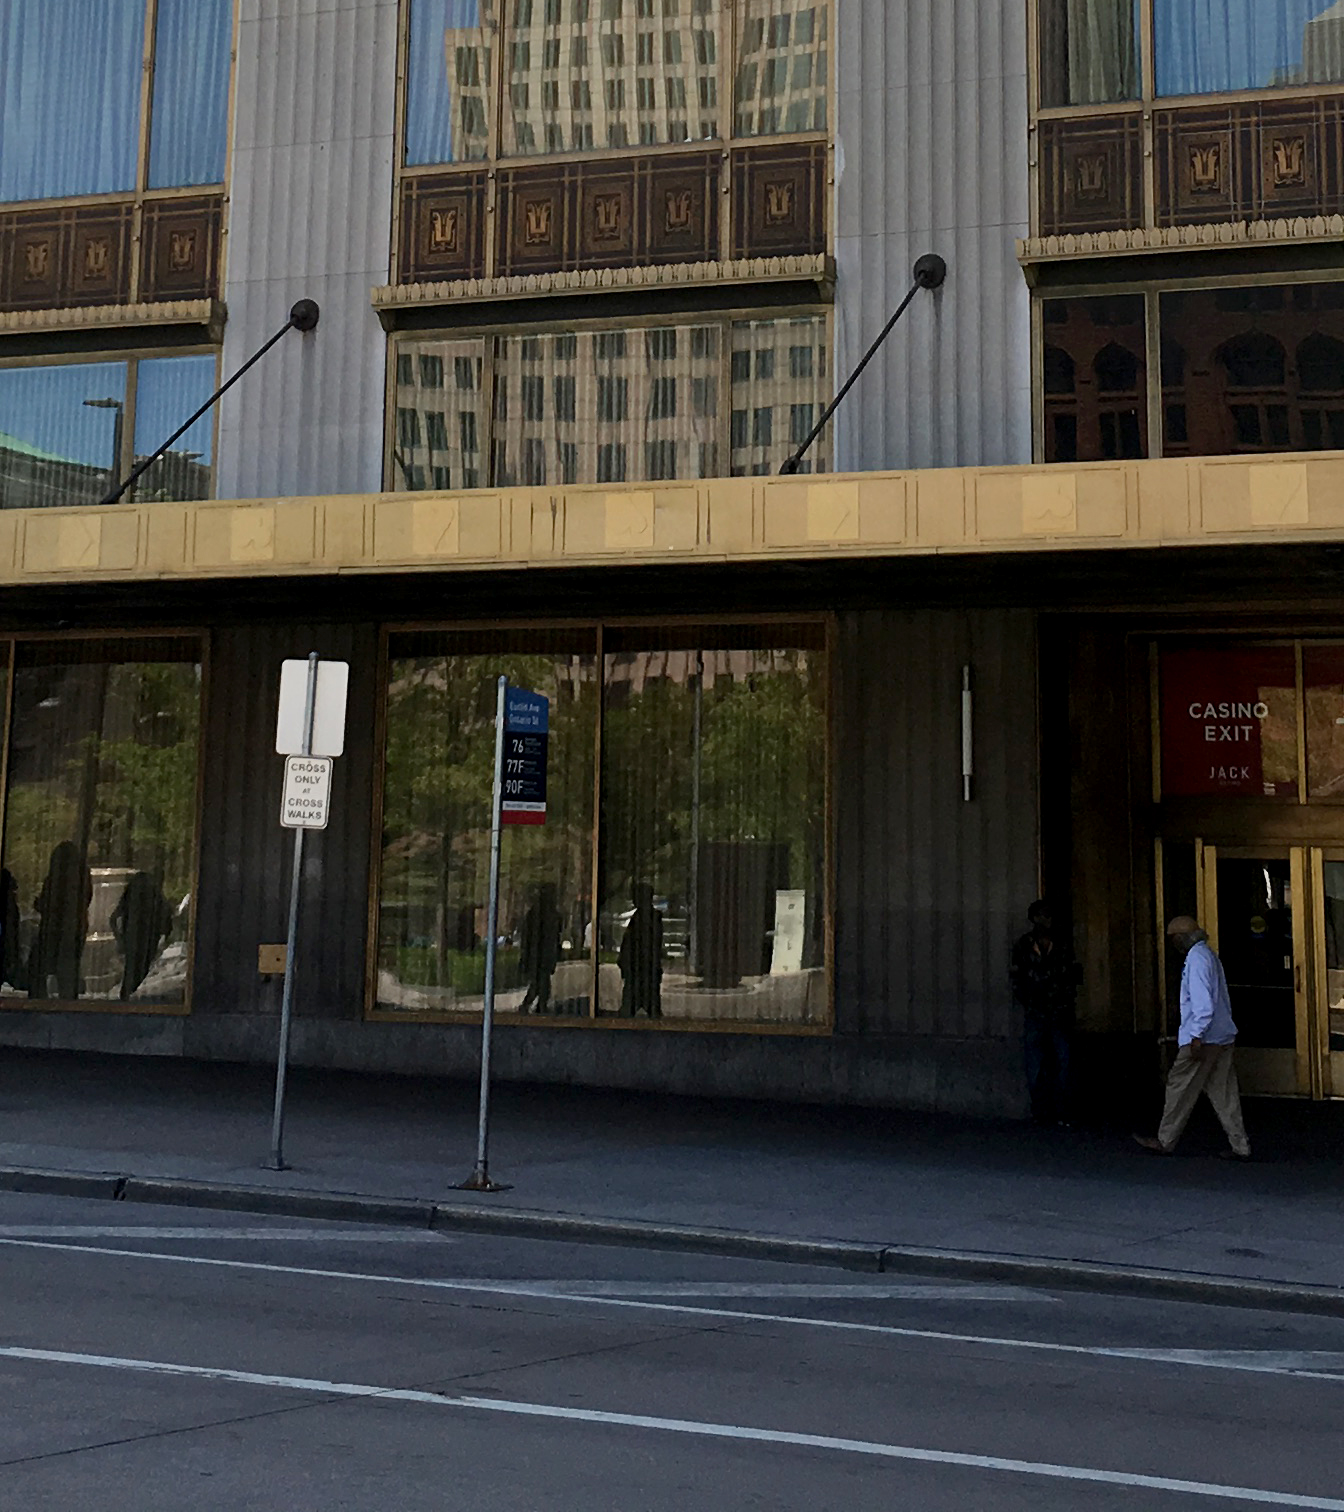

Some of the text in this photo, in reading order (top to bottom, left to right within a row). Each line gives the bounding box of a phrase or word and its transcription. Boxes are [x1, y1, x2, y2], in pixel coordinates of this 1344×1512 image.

[1188, 702, 1269, 719] CASINO
[1204, 725, 1254, 742] EXIT
[512, 739, 524, 753] 76
[290, 763, 326, 773] CROSS
[506, 759, 525, 774] 77F
[1209, 766, 1250, 779] JACK
[294, 775, 321, 784] ONLY
[506, 779, 524, 794] 90F
[288, 798, 323, 808] CROSS
[287, 810, 322, 820] WALKS
